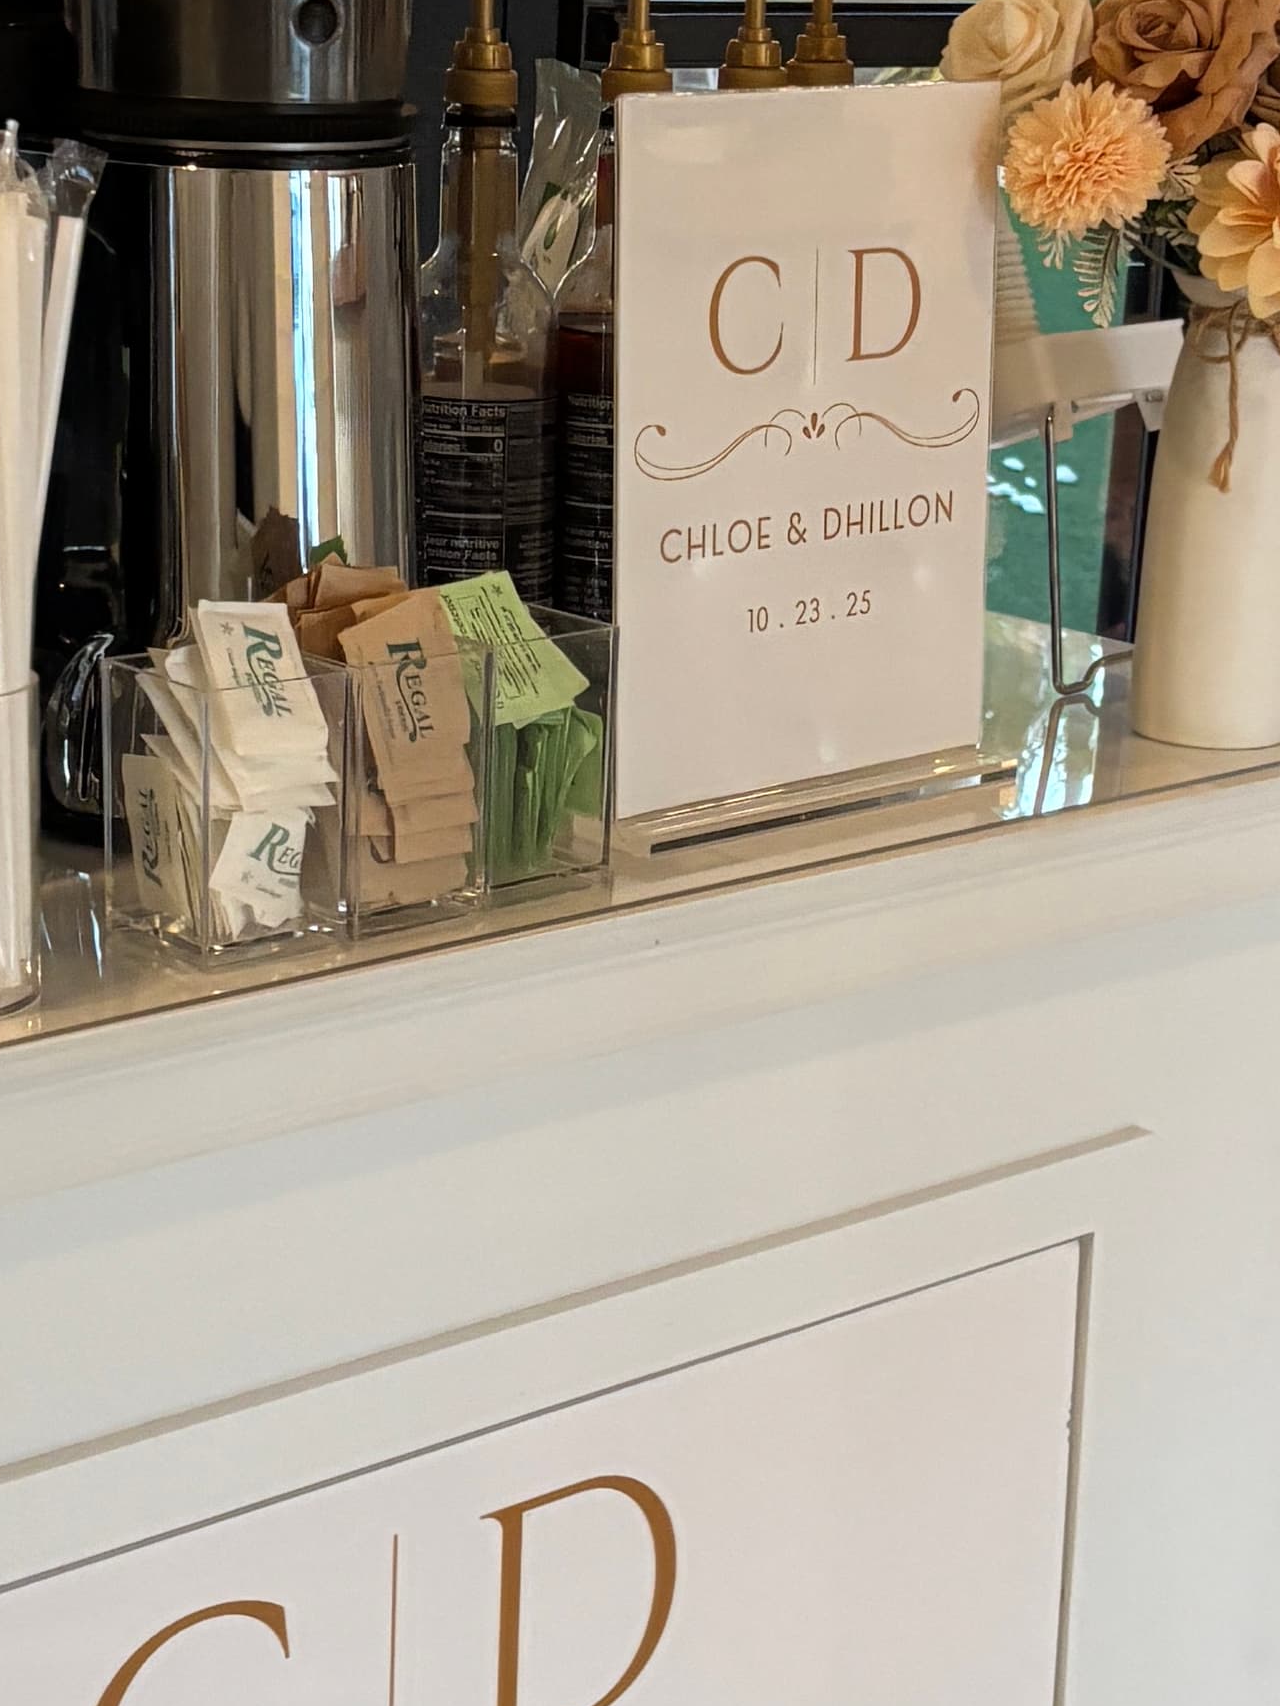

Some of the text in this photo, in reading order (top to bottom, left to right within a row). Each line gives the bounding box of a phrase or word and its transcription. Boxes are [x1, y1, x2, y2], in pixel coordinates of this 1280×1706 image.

[709, 246, 921, 377] C D
[493, 439, 503, 453] 0
[659, 490, 956, 564] CHLOE & DHILLON
[746, 606, 770, 634] 10
[795, 598, 822, 626] 23
[845, 590, 873, 618] 25
[386, 638, 434, 742] REGAL
[247, 823, 303, 875] REG
